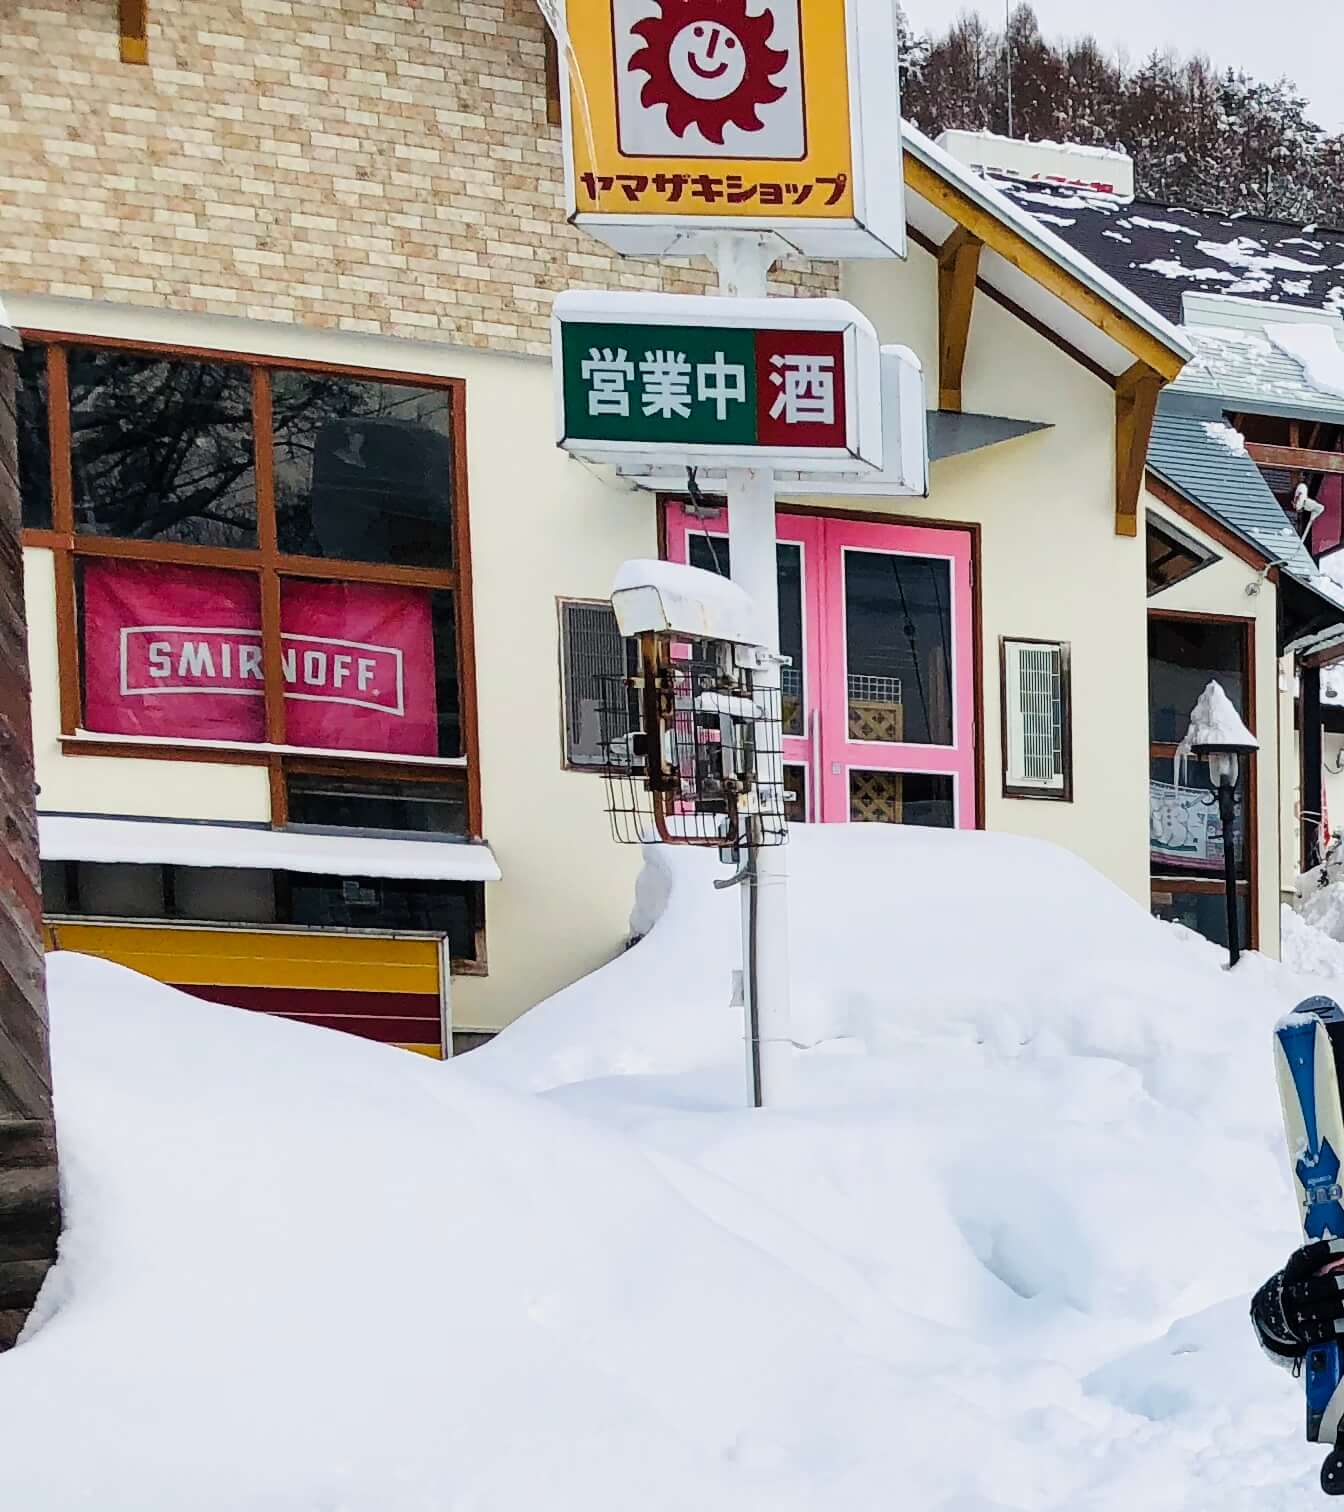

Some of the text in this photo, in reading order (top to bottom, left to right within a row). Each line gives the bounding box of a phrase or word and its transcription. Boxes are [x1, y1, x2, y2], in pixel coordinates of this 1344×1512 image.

[580, 172, 847, 205] ヤマザキショップ
[581, 347, 746, 421] 営業中
[768, 354, 835, 425] 酒
